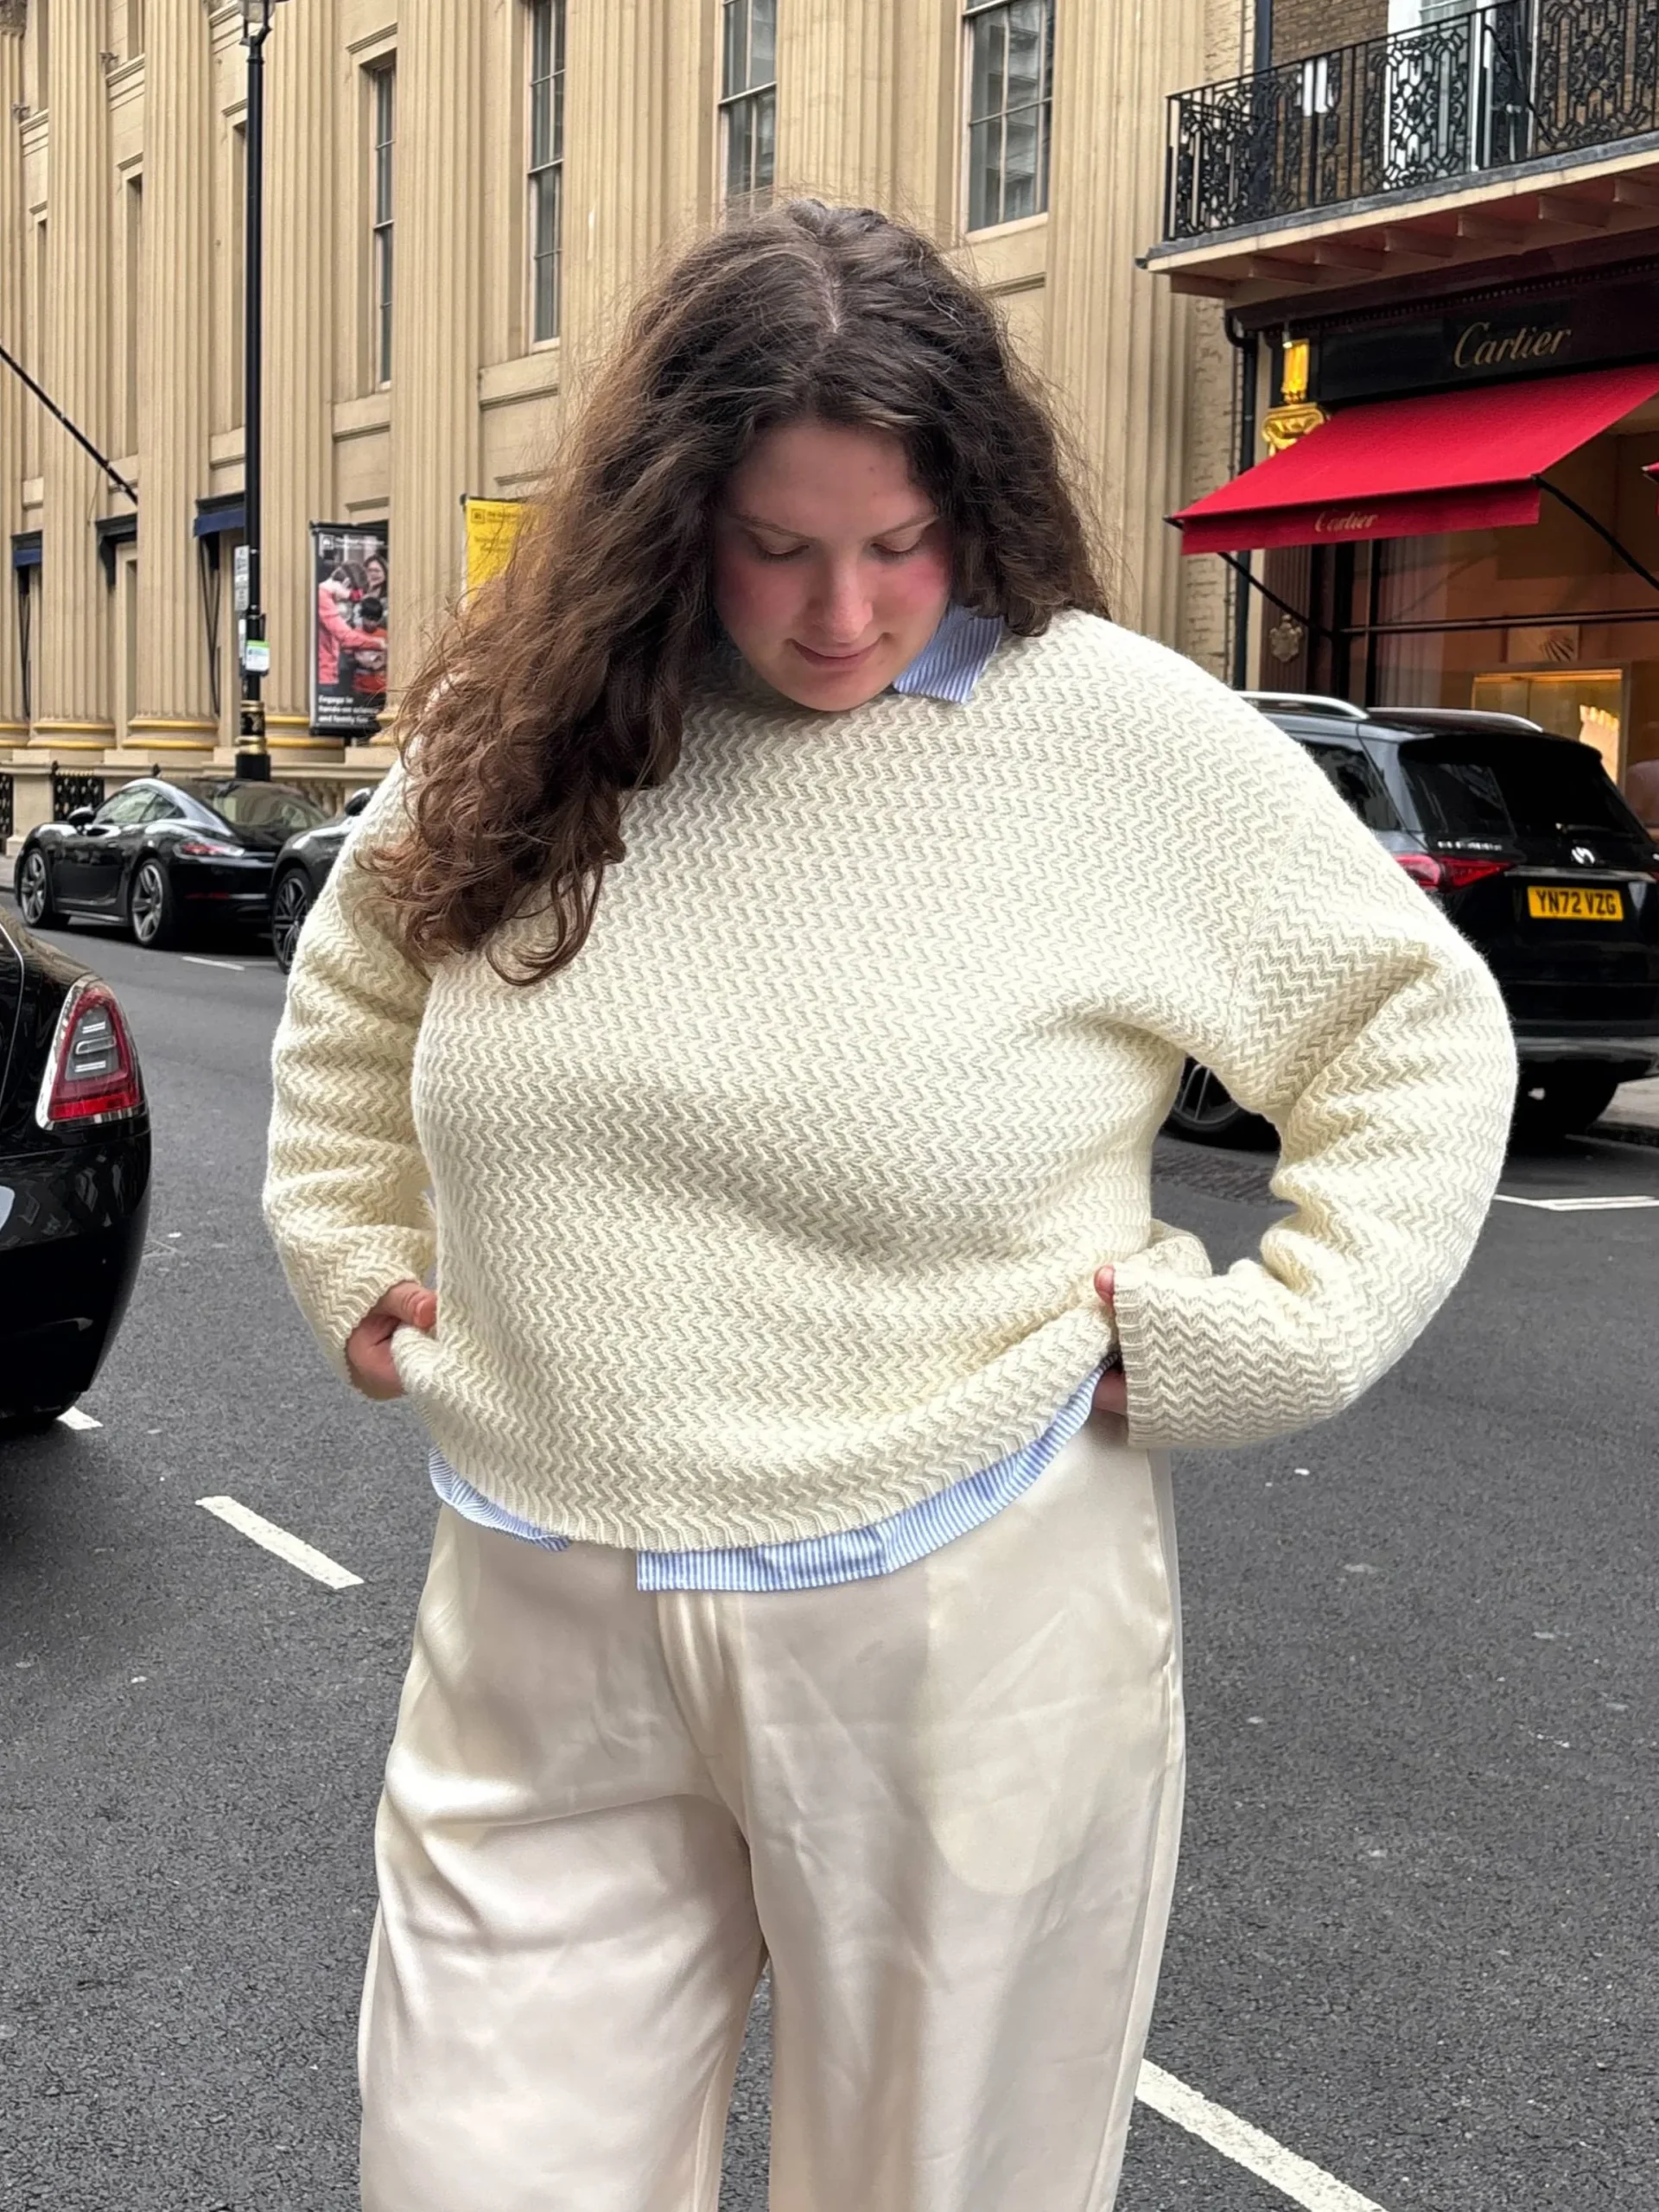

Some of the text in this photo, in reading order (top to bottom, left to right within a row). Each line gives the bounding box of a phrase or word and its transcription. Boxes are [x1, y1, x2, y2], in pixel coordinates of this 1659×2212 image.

[1454, 321, 1572, 368] Cartier
[1314, 510, 1378, 532] Cartier
[1535, 889, 1617, 916] YN72 VZG
